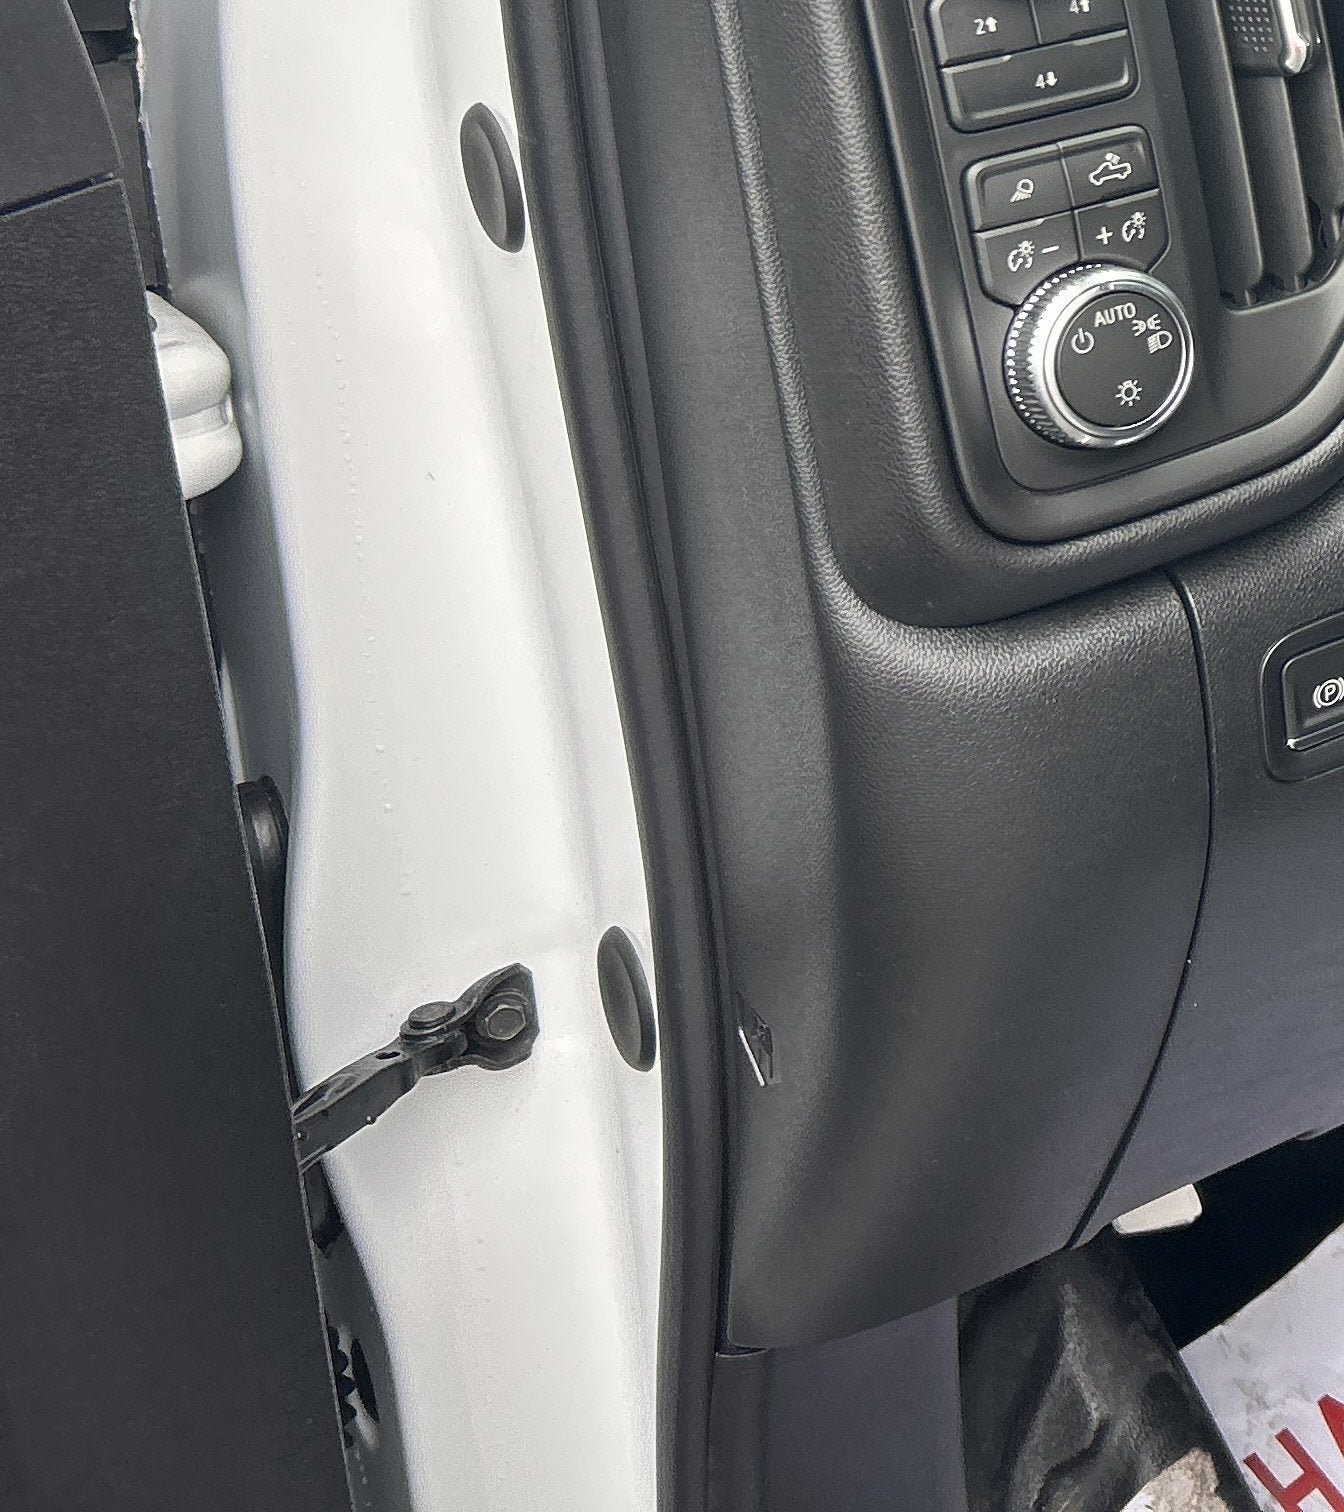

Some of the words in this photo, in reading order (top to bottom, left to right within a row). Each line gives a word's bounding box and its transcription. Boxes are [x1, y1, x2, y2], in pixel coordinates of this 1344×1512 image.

[1069, 0, 1080, 14] 4
[973, 18, 987, 36] 2
[1034, 73, 1046, 89] 4
[1093, 301, 1137, 328] AUTO
